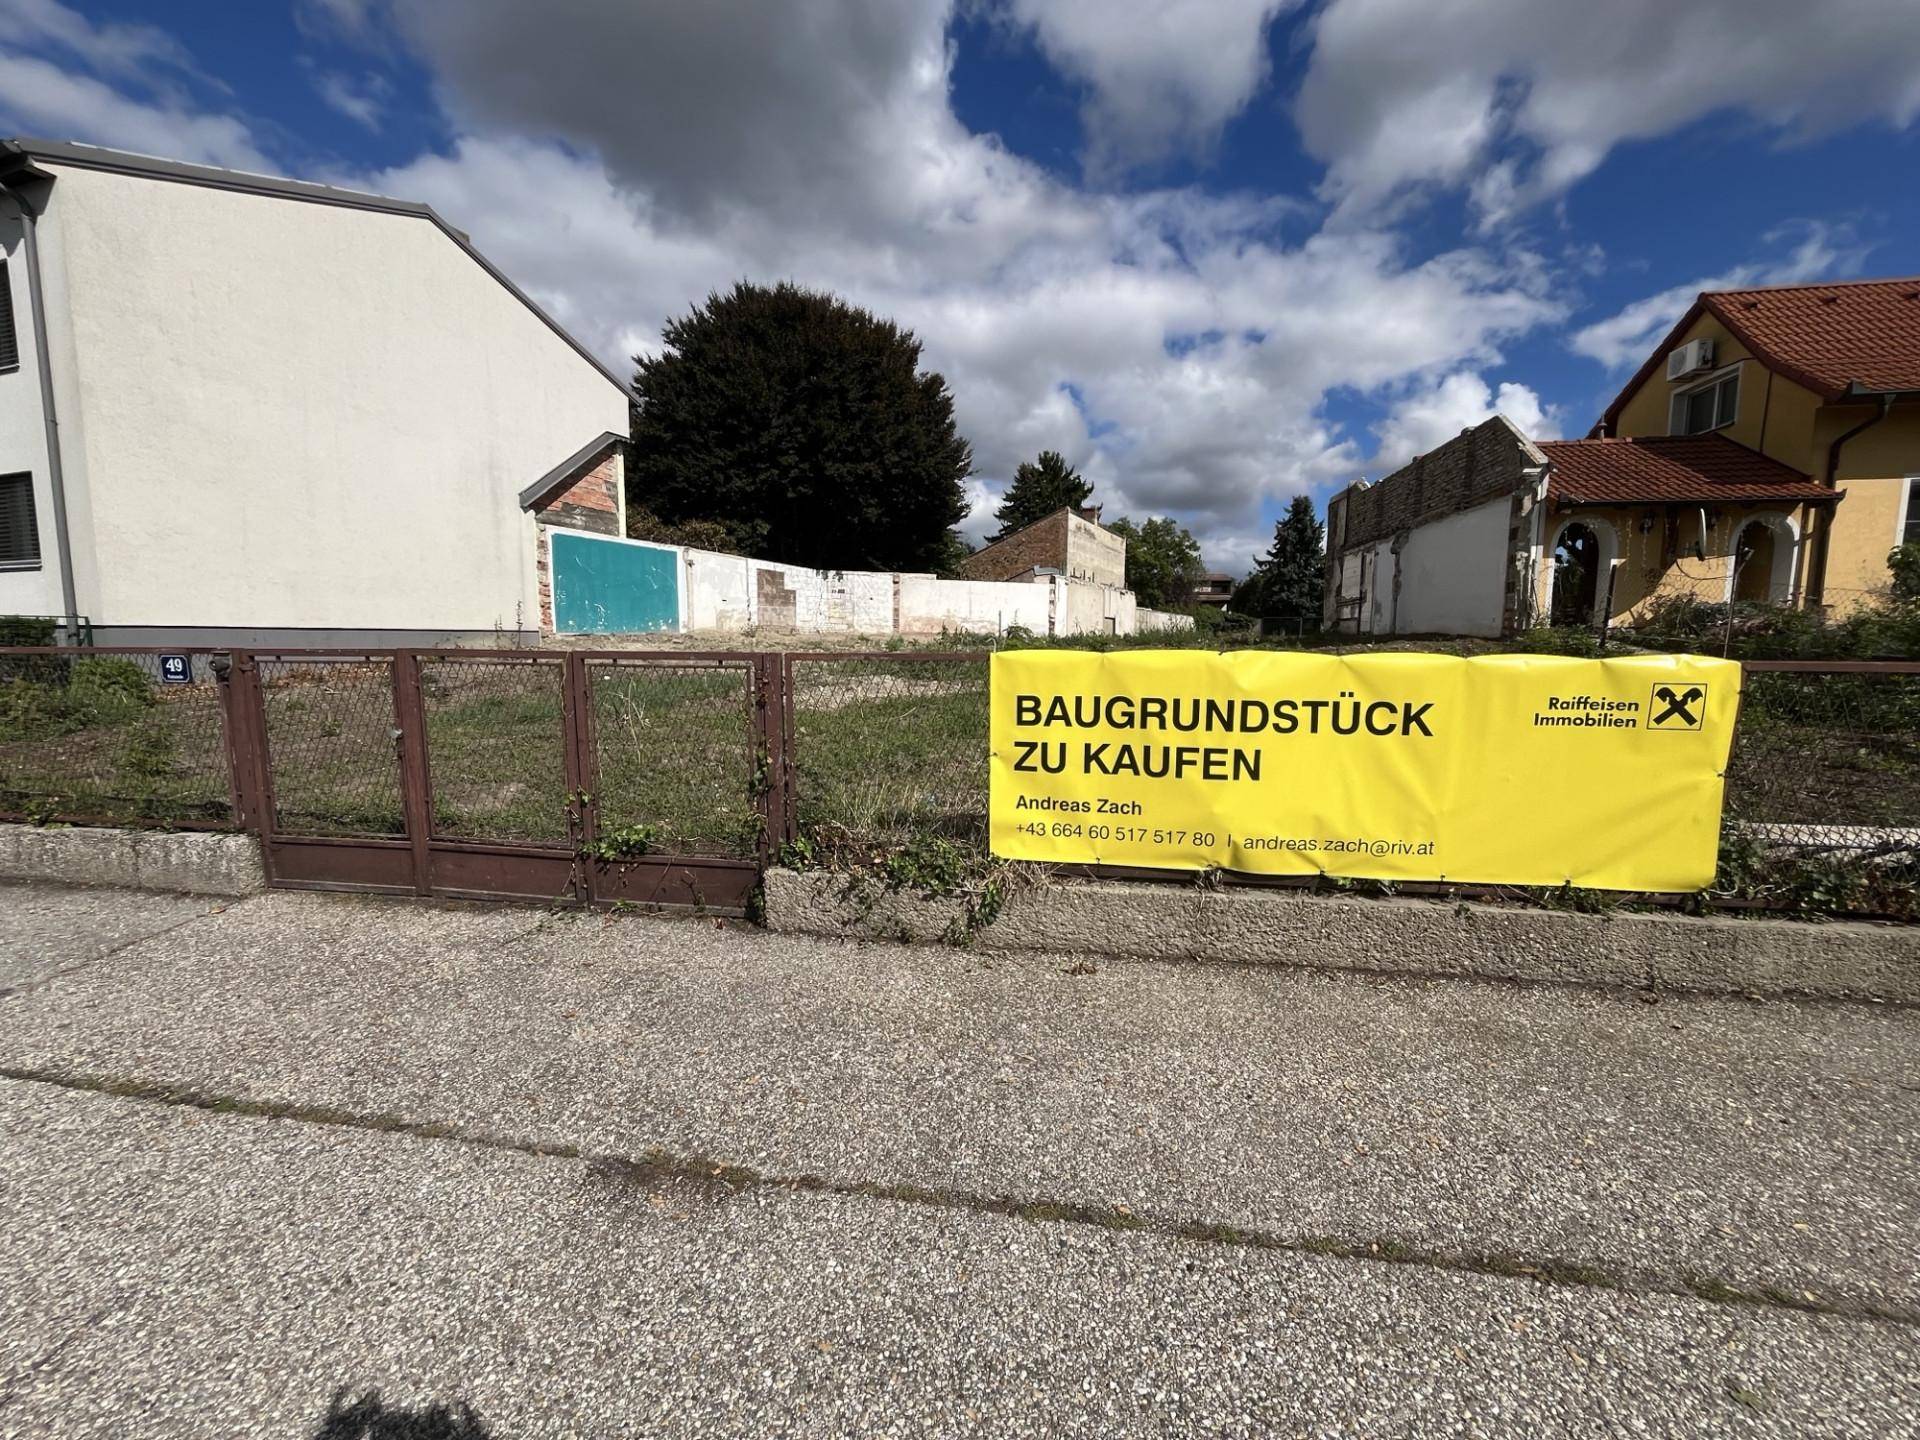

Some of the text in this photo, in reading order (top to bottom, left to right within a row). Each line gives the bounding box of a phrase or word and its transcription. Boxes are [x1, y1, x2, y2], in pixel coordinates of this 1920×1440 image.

[165, 658, 183, 672] 49
[1016, 690, 1435, 737] BAUGRUNDSTÜCK
[1548, 695, 1640, 712] Raiffeisen
[1533, 711, 1637, 728] Immobilien
[1013, 740, 1262, 782] ZU KAUFEN
[1015, 794, 1142, 816] Andreas Zach
[1016, 822, 1046, 837] +43
[1051, 822, 1083, 838] 664
[1088, 825, 1110, 840] 60
[1115, 827, 1148, 842] 517
[1153, 829, 1187, 845] 517
[1192, 831, 1215, 848] 80
[1243, 835, 1435, 858] andreas.zach@riv.at
